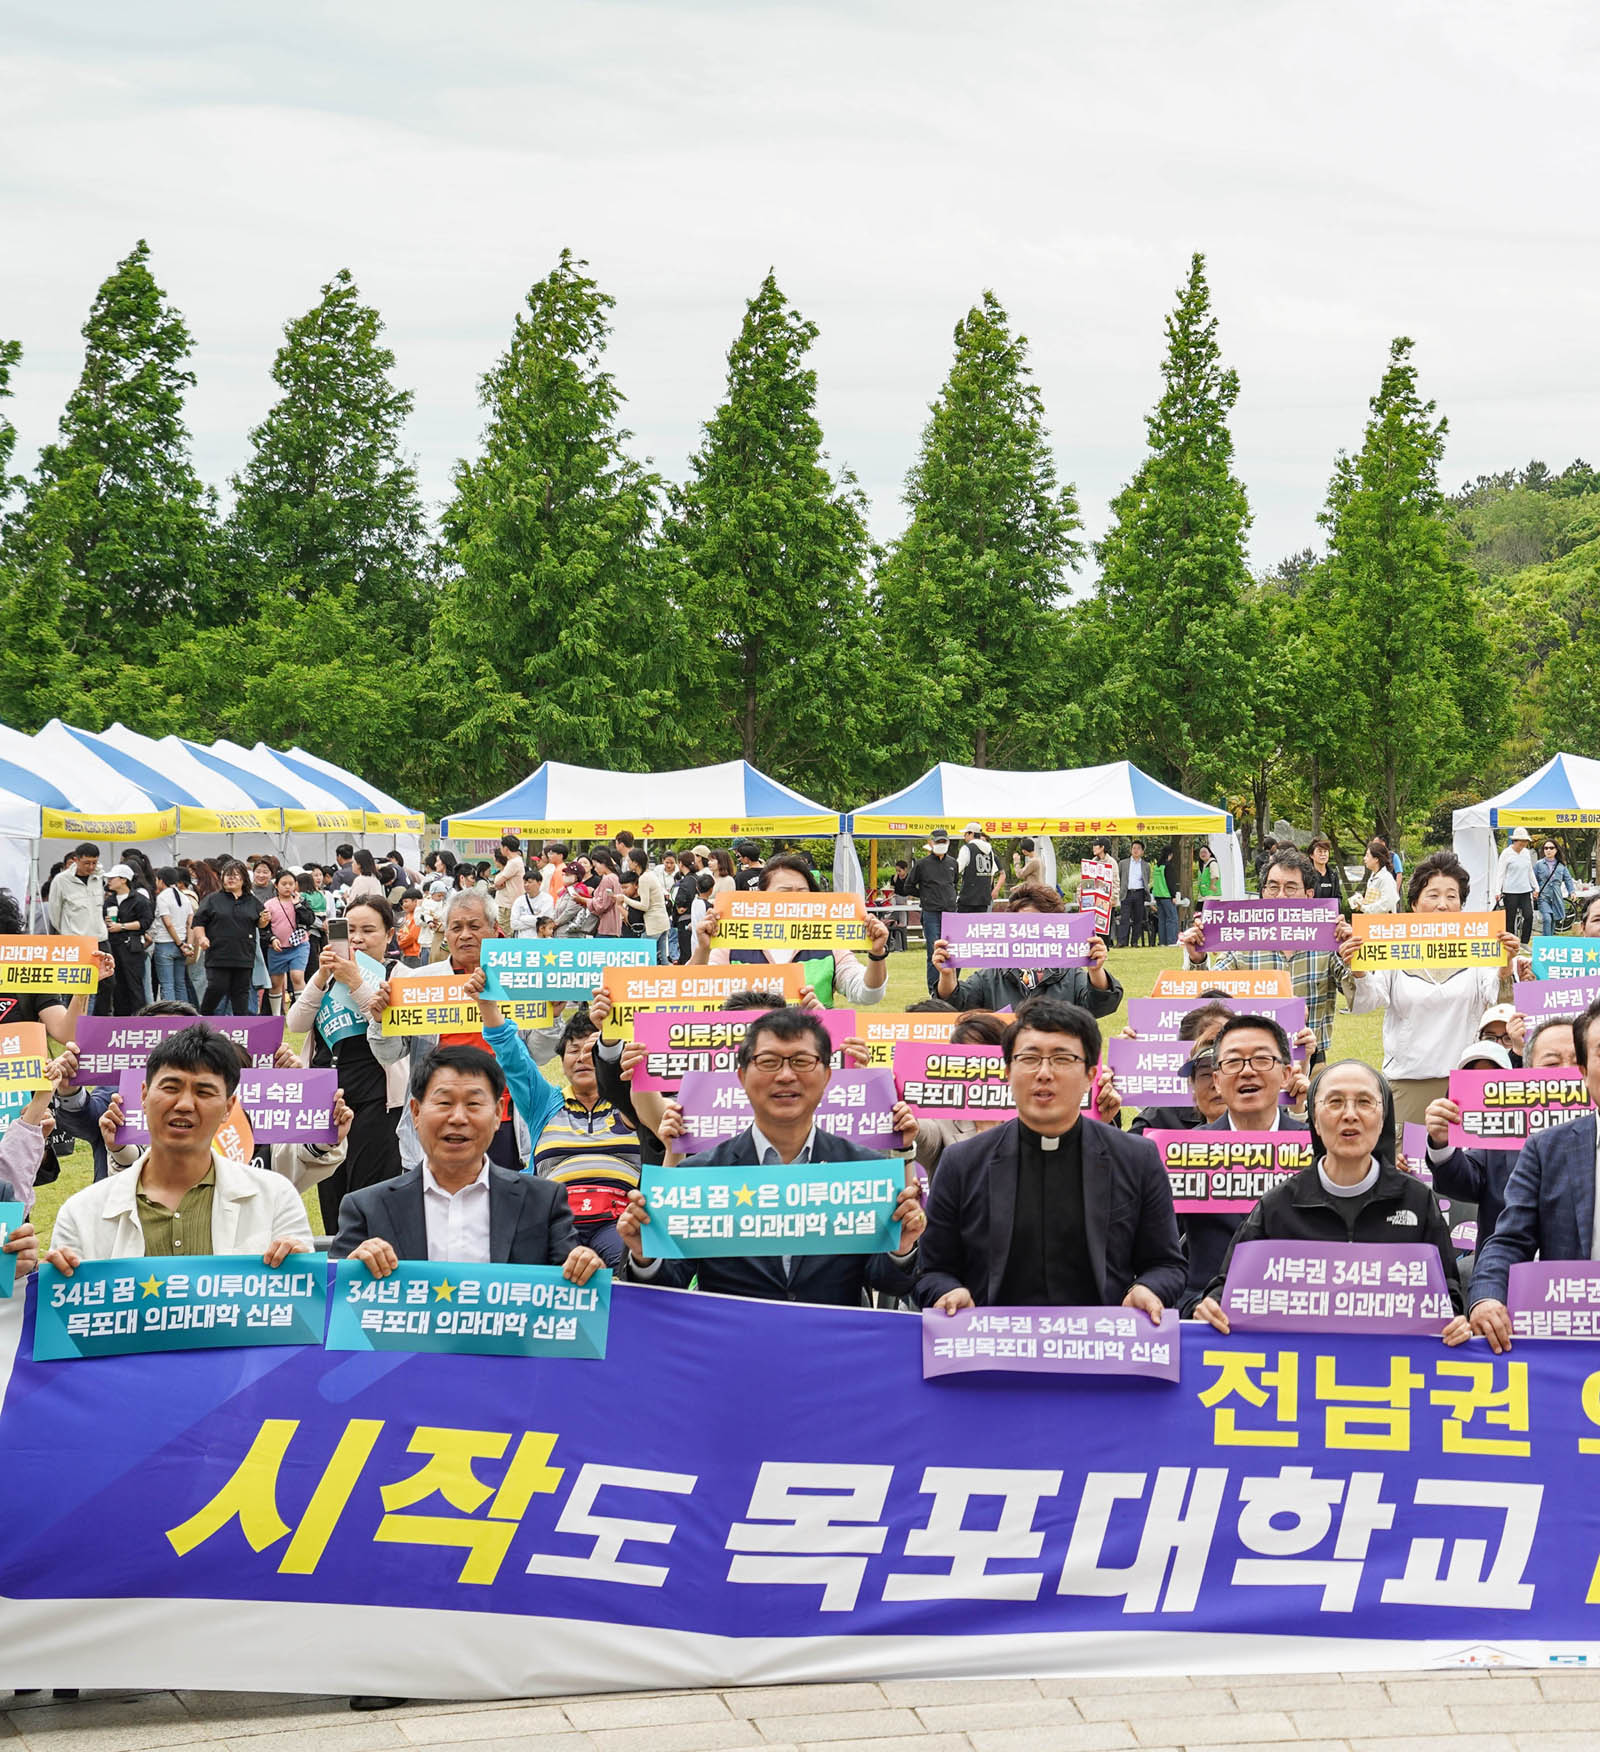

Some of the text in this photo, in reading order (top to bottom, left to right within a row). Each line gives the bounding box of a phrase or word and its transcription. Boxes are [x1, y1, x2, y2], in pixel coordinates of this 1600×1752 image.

[731, 901, 855, 919] 전남권 의과대학 신설
[717, 922, 866, 941] 시작도 목포대, 마침표도 목포대
[966, 923, 1069, 938] 서부권 34년 숙원
[1369, 922, 1489, 938] 전남권 의과대학 신설
[52, 945, 79, 961] 신설
[488, 951, 649, 967] 34년 이루어진다
[947, 942, 1090, 958] 국립목포대 의과대학 신설
[1357, 942, 1500, 961] 시작도 목포대, 마침표도 목포대
[8, 967, 91, 983] 마침표도 목포대
[1484, 1082, 1588, 1107] 의료취약지
[1463, 1113, 1526, 1136] 목포대
[1167, 1143, 1272, 1168] 의료취약지
[650, 1179, 894, 1208] 34년 이루어진다
[668, 1210, 875, 1238] 목포대 의과대학 신설
[1263, 1257, 1428, 1286] 서부권 34년 숙원
[51, 1272, 314, 1306] 34년 이루어진다
[346, 1278, 598, 1311] 34년 이루어진다
[1229, 1288, 1330, 1313] 국립목포대
[1333, 1293, 1415, 1316] 의과대학
[67, 1304, 292, 1337] 목포대 의과대학 신설
[360, 1311, 577, 1340] 목포대 의과대학 신설
[967, 1316, 1136, 1338] 서부권 34년 숙원
[934, 1338, 1170, 1366] 국립목포대 의과대학 신설
[1198, 1350, 1531, 1457] 전남권
[165, 1419, 697, 1587] 시작도
[725, 1461, 1544, 1613] 목포대학교
